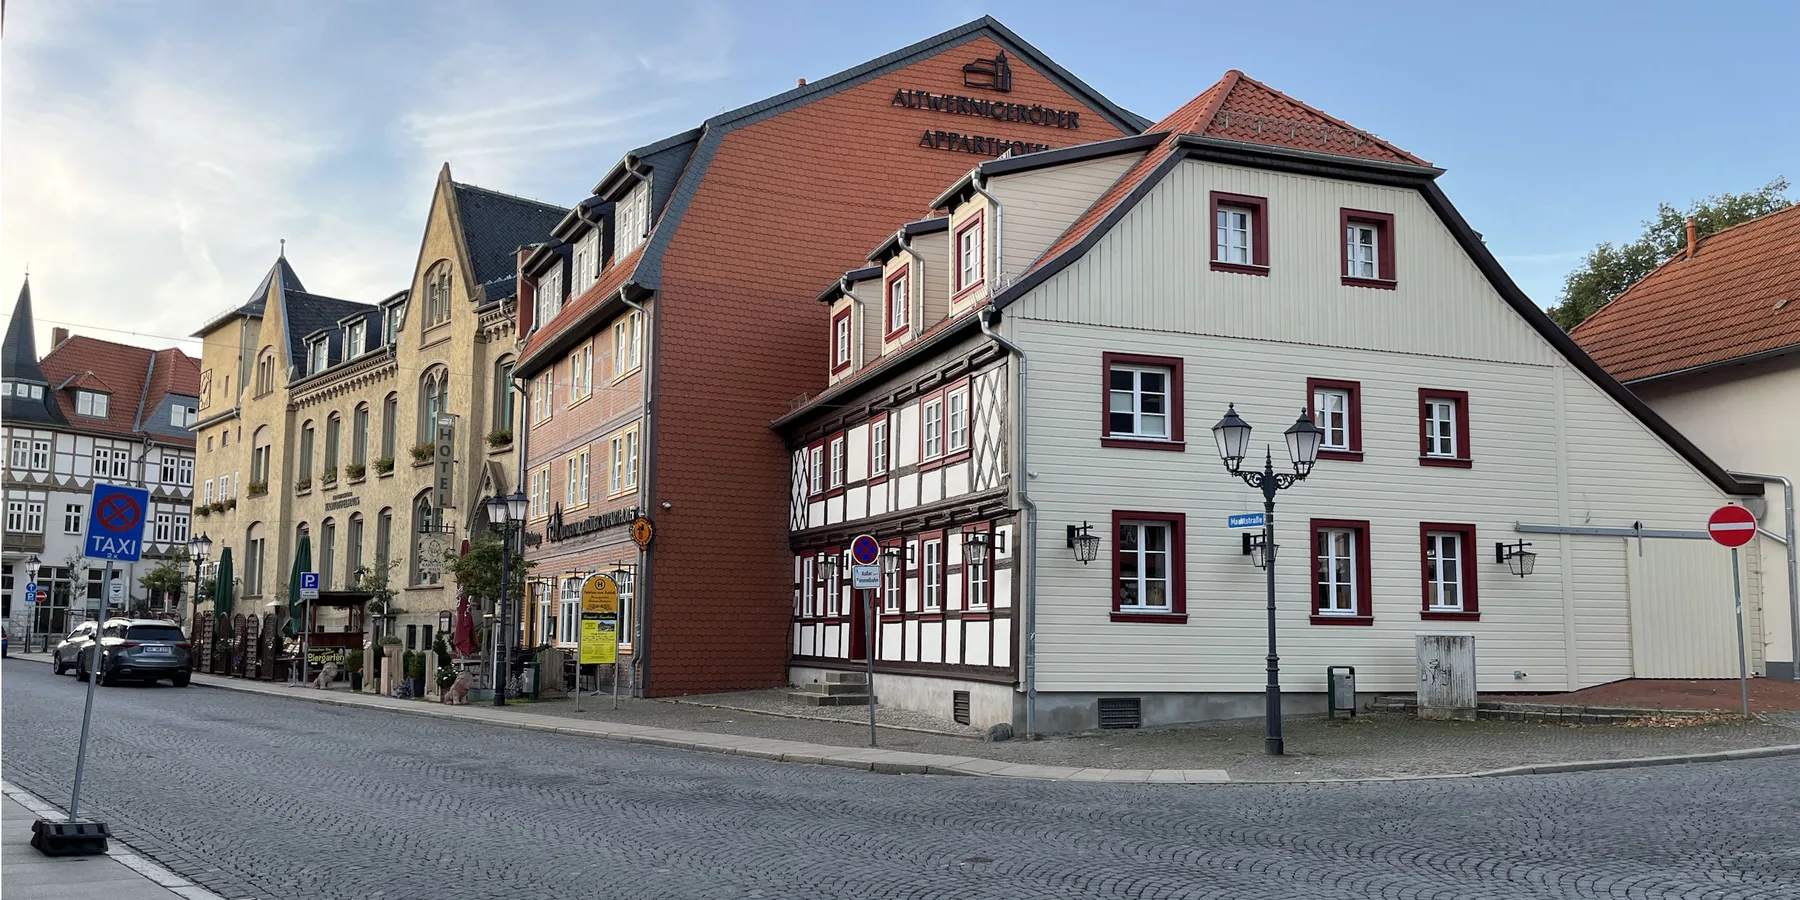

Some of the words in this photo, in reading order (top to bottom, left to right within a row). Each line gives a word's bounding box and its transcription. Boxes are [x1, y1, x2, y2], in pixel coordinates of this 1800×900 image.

[891, 88, 1080, 130] ALTWERNIGERÖDER
[439, 428, 451, 506] HOTEL
[92, 535, 136, 556] TAXI
[305, 575, 315, 588] P
